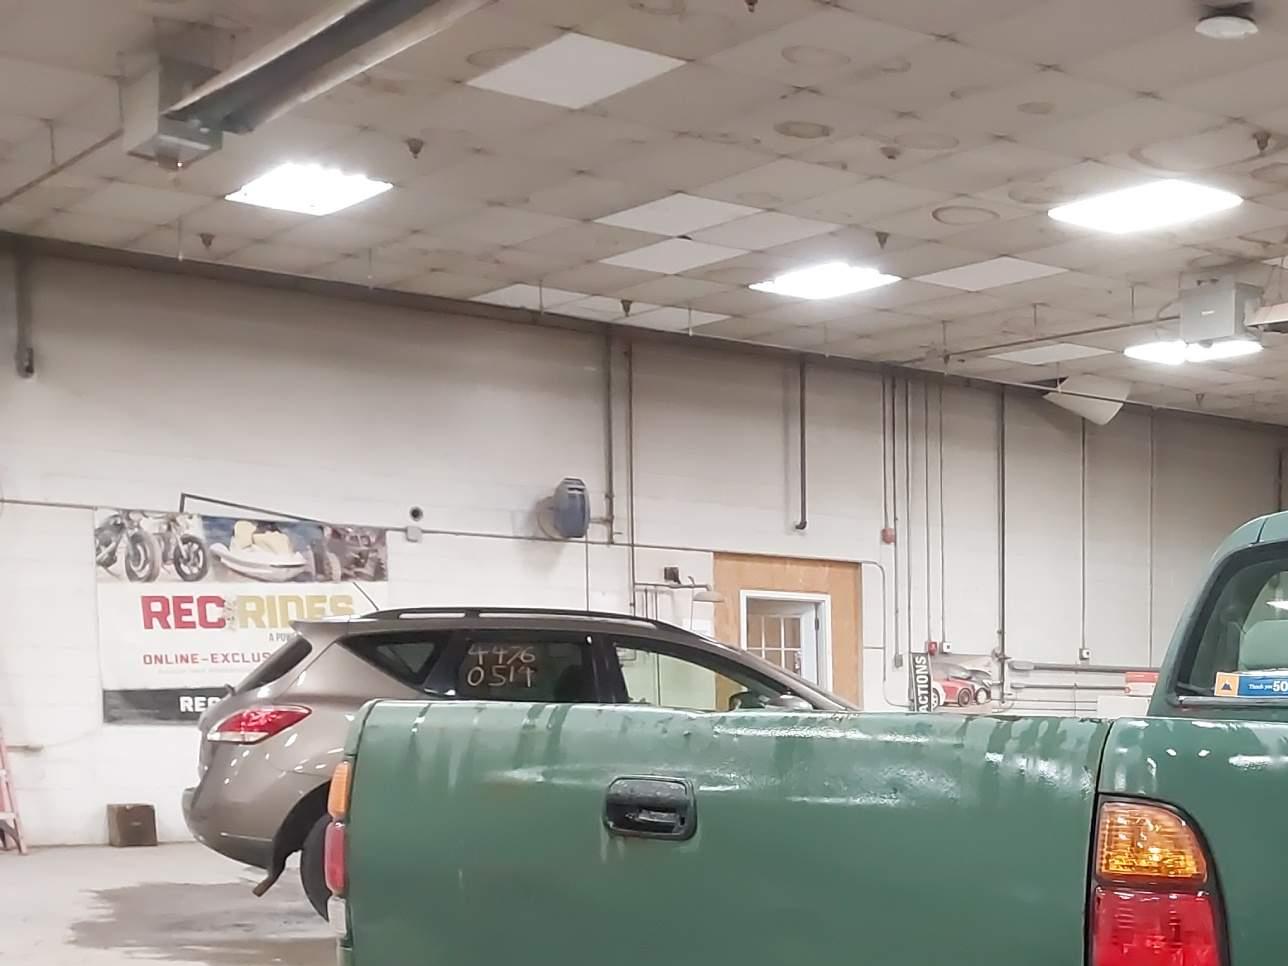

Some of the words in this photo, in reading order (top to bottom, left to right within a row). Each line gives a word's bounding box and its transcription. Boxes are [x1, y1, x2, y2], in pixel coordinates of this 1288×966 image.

[141, 595, 226, 630] REC
[468, 643, 536, 665] 4476
[1272, 680, 1288, 692] 50
